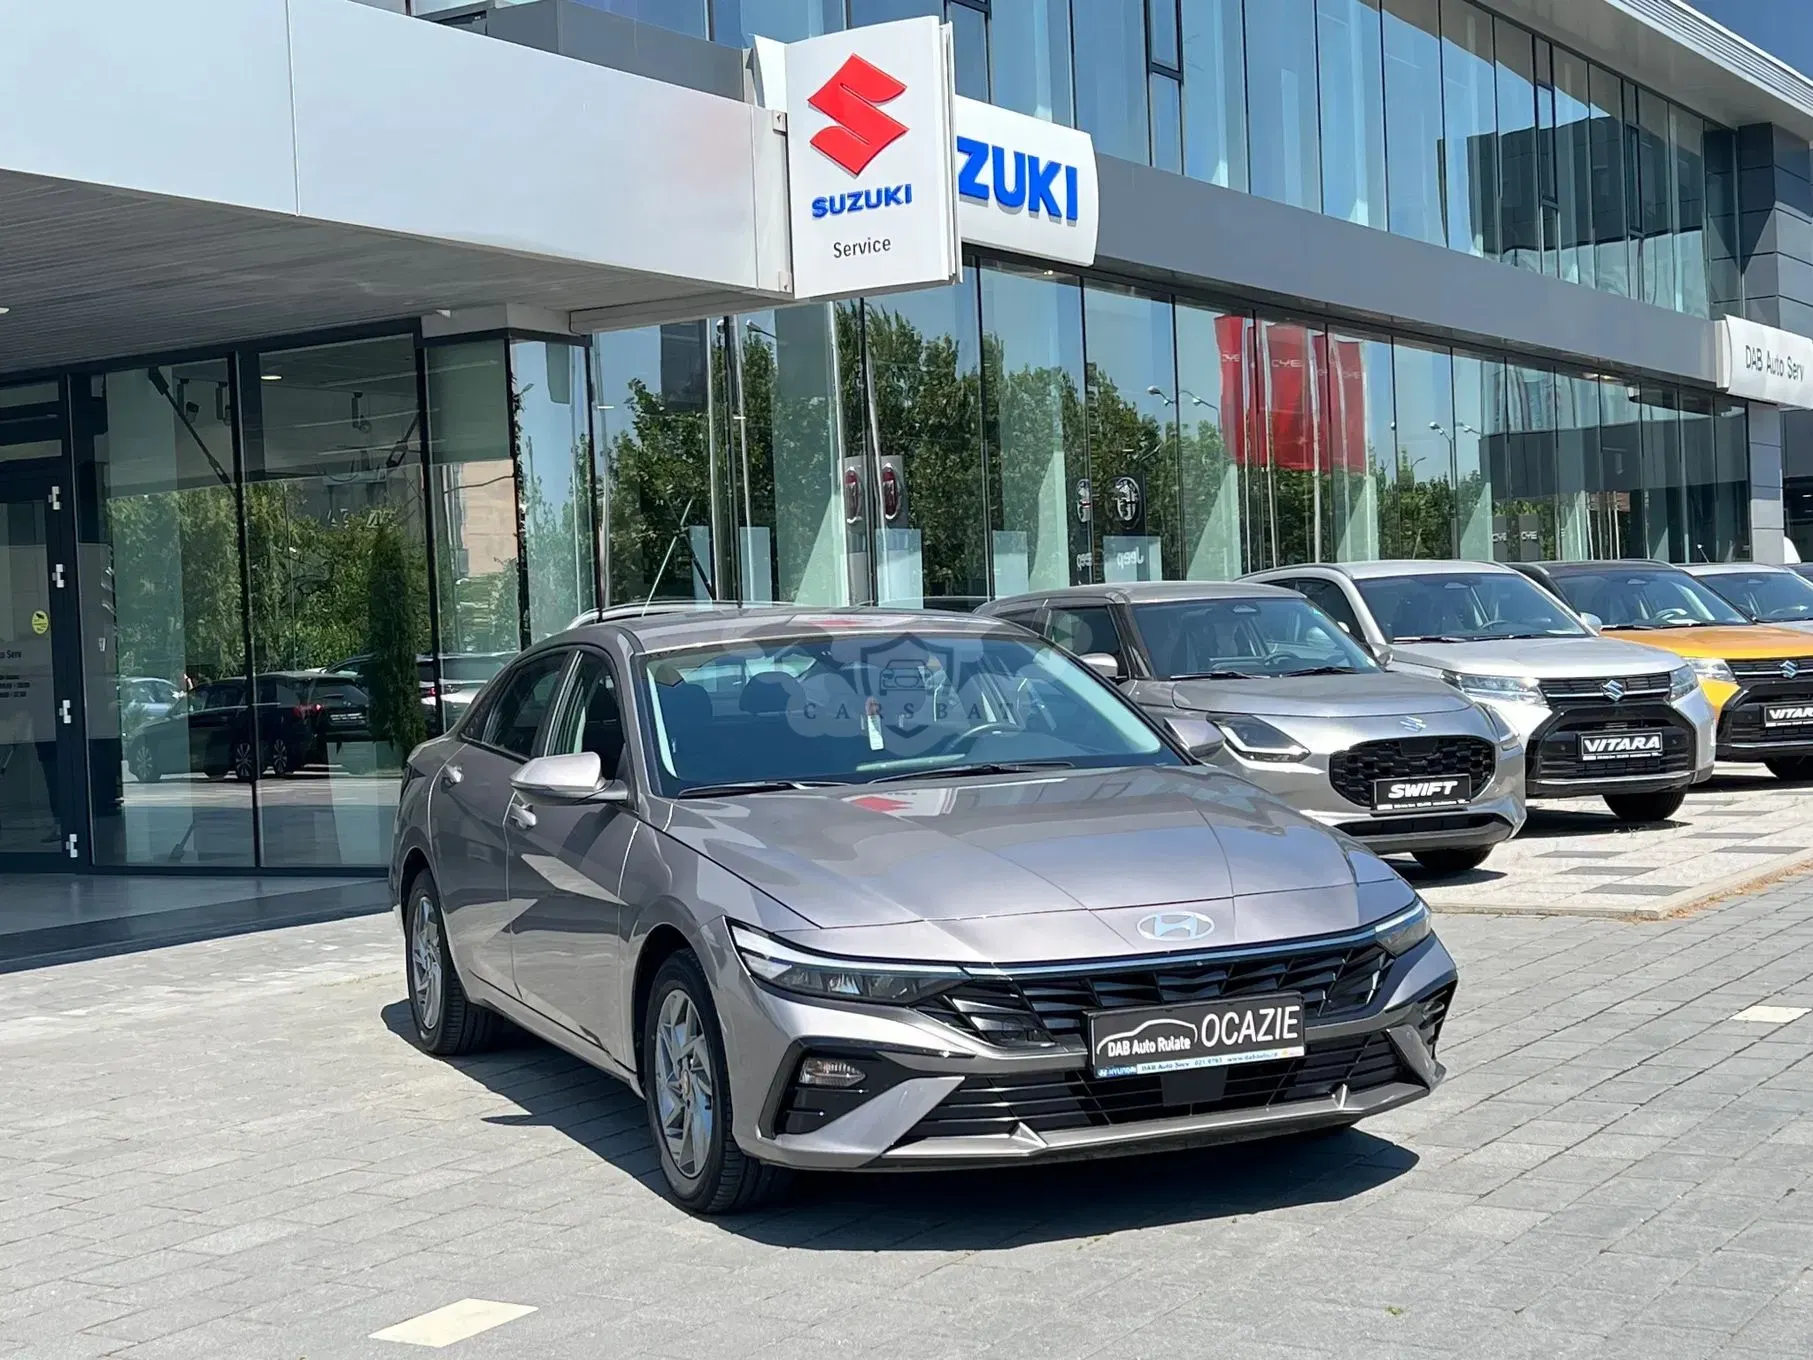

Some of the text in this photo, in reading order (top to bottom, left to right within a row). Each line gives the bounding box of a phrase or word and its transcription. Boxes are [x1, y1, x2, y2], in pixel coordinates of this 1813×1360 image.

[956, 136, 1078, 221] ZUKI
[811, 183, 913, 220] SUZUKI
[833, 237, 892, 259] Service
[1745, 345, 1805, 382] DAB Auto Serv
[1769, 707, 1813, 719] VITAR
[1584, 736, 1660, 752] VITARA
[1388, 781, 1458, 799] SWIFT
[1201, 1005, 1300, 1047] OCAZIE
[1107, 1035, 1191, 1057] DAB Auto Rulate
